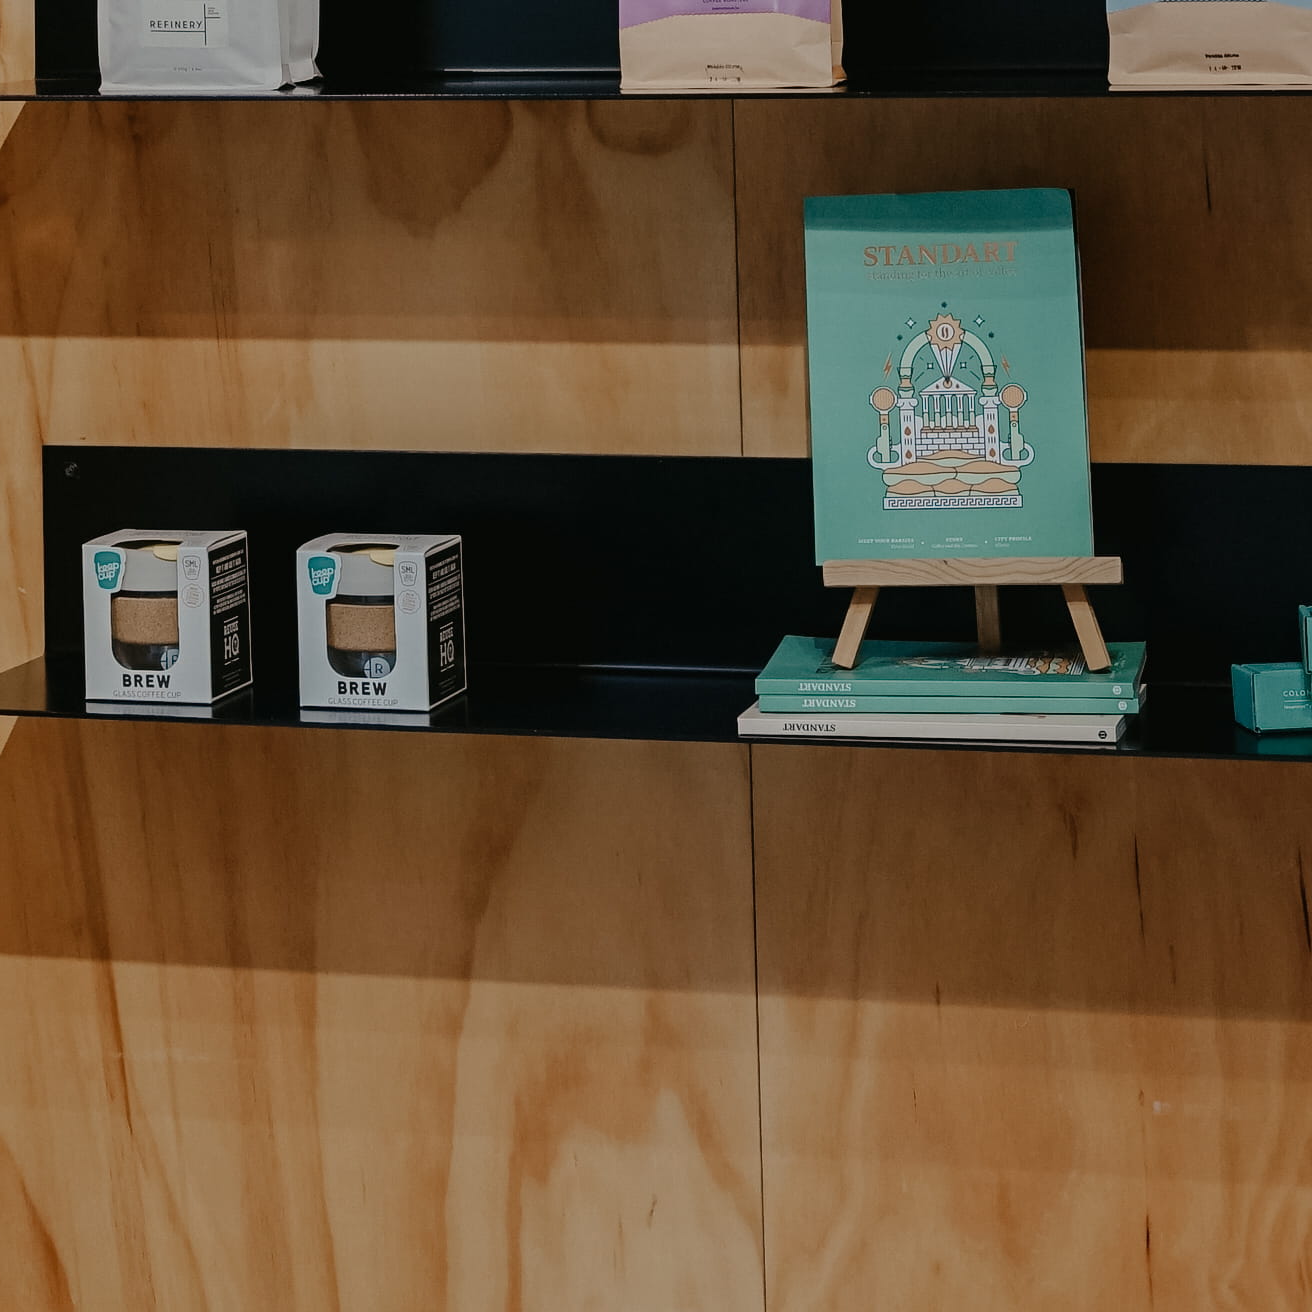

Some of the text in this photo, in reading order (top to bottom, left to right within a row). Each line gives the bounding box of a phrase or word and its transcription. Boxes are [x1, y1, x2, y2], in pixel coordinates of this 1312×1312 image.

[149, 20, 203, 29] REFINERY
[863, 241, 1018, 267] STANDART
[97, 562, 119, 575] keep
[311, 567, 334, 579] keep
[98, 570, 116, 581] cup
[312, 576, 330, 587] cup
[224, 633, 240, 660] HQ
[440, 639, 455, 667] HQ
[122, 674, 171, 689] BREW
[798, 682, 852, 692] STANDART
[338, 681, 387, 696] BREW
[113, 690, 182, 699] GLASS COFFEE CUP
[328, 697, 399, 707] GLASS COFFEE CUP
[802, 698, 856, 708] STANDART
[783, 722, 836, 732] STANDART
